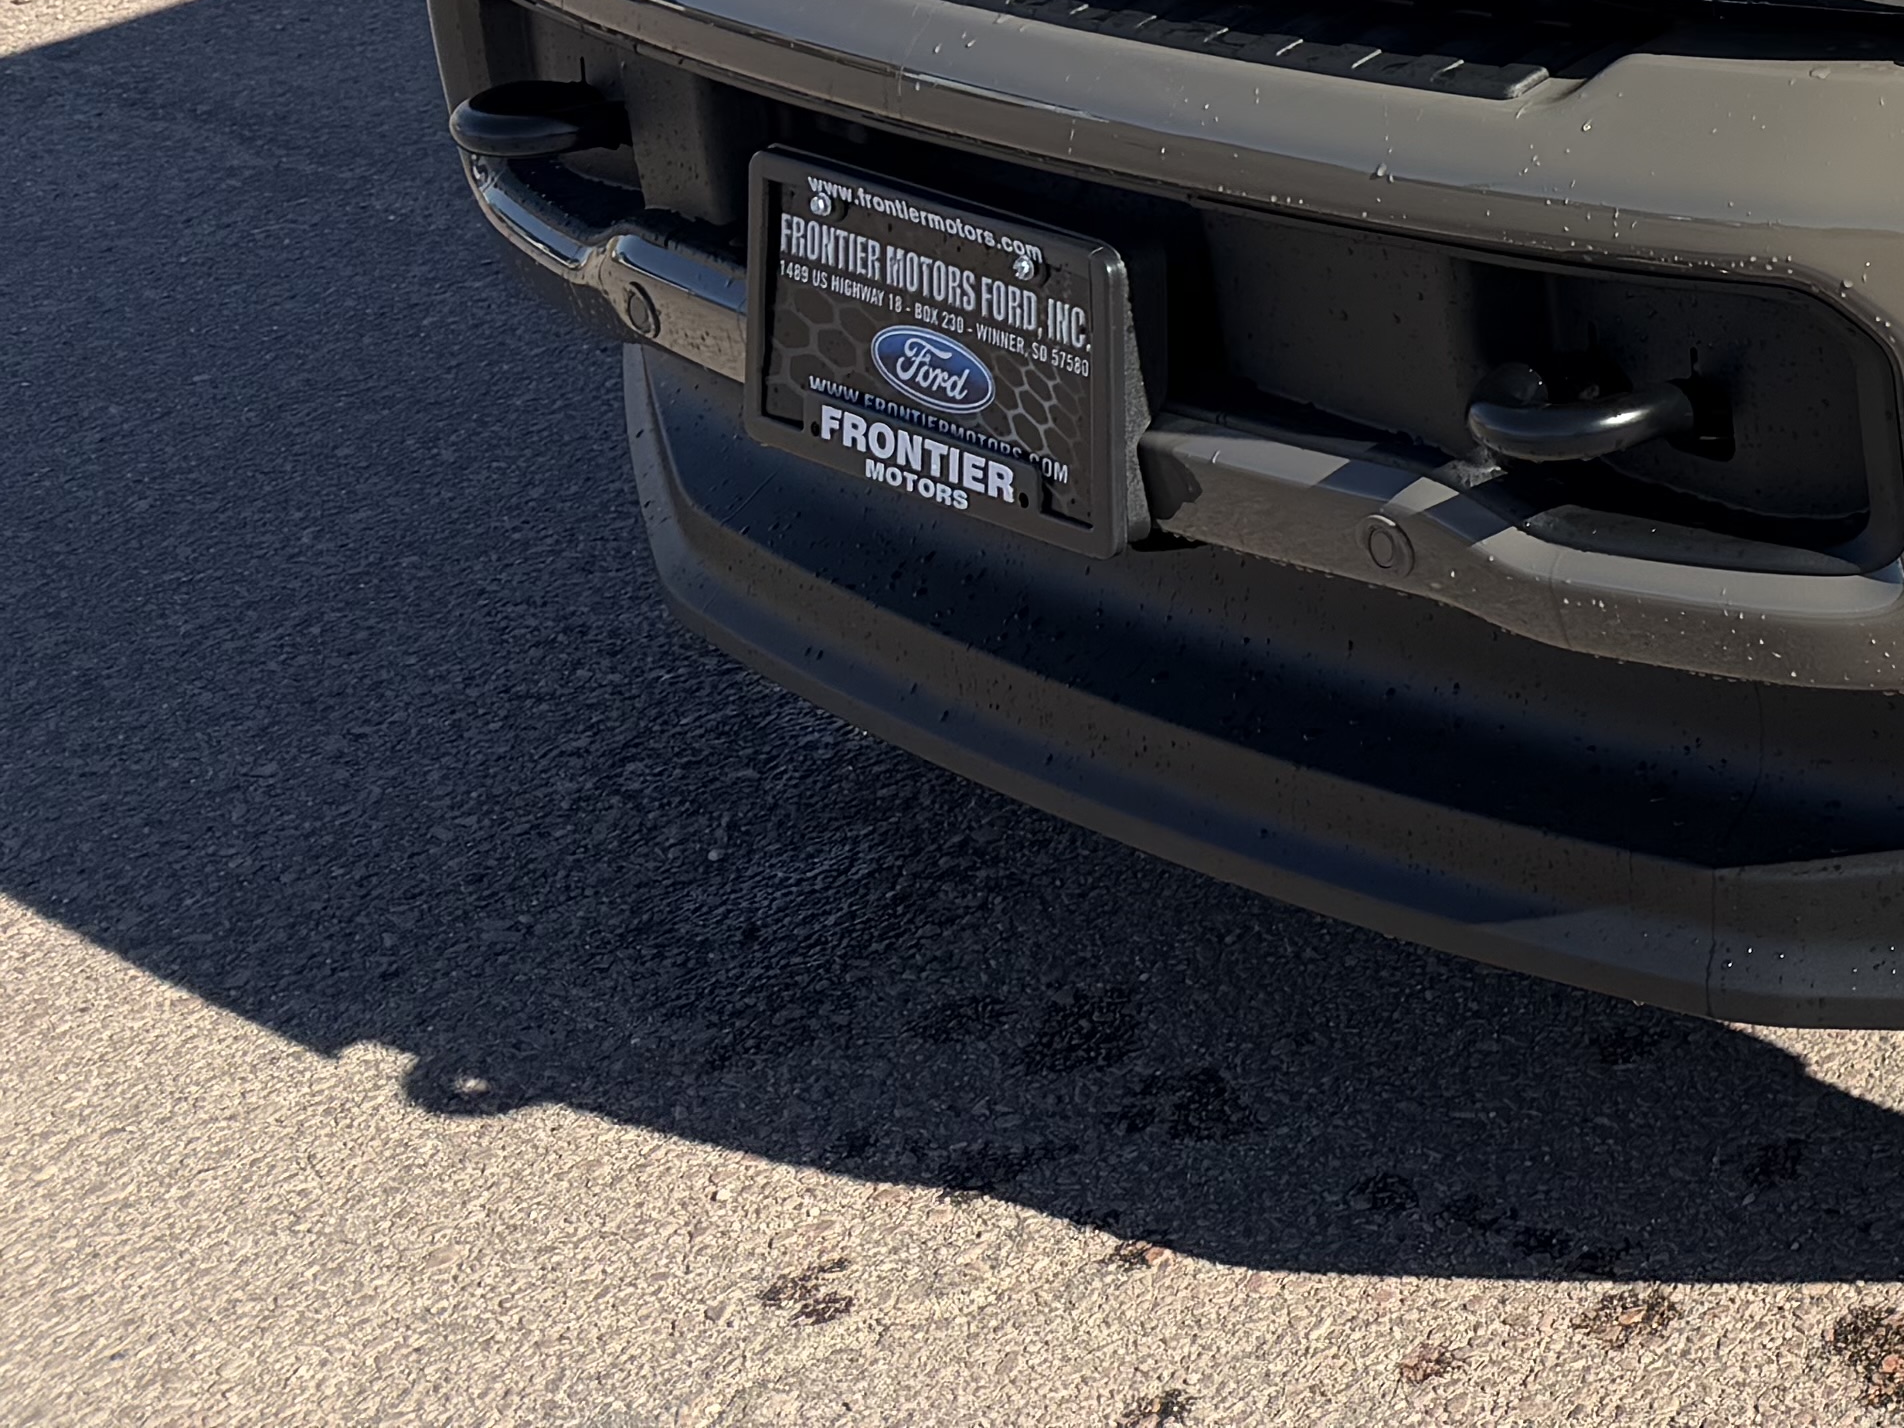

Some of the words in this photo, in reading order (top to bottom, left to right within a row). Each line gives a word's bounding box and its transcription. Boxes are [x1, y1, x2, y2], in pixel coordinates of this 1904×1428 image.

[807, 175, 1043, 264] www.frontiermotors.com
[779, 260, 809, 283] 1489
[812, 269, 828, 289] US
[831, 275, 885, 307] HIGHWAY
[888, 294, 902, 313] 18
[915, 302, 939, 326] BOX
[941, 311, 964, 334] 230
[976, 323, 1029, 358] WINNER,
[1031, 342, 1048, 362] SD
[1051, 349, 1089, 377] 57580
[780, 212, 881, 281] FRONTIER
[886, 245, 976, 311] MOTORS
[981, 276, 1043, 340] FORD,
[1047, 298, 1092, 352] INC.
[896, 337, 970, 400] Ford
[821, 405, 1014, 503] FRONTIER
[865, 459, 968, 510] MOTORS
